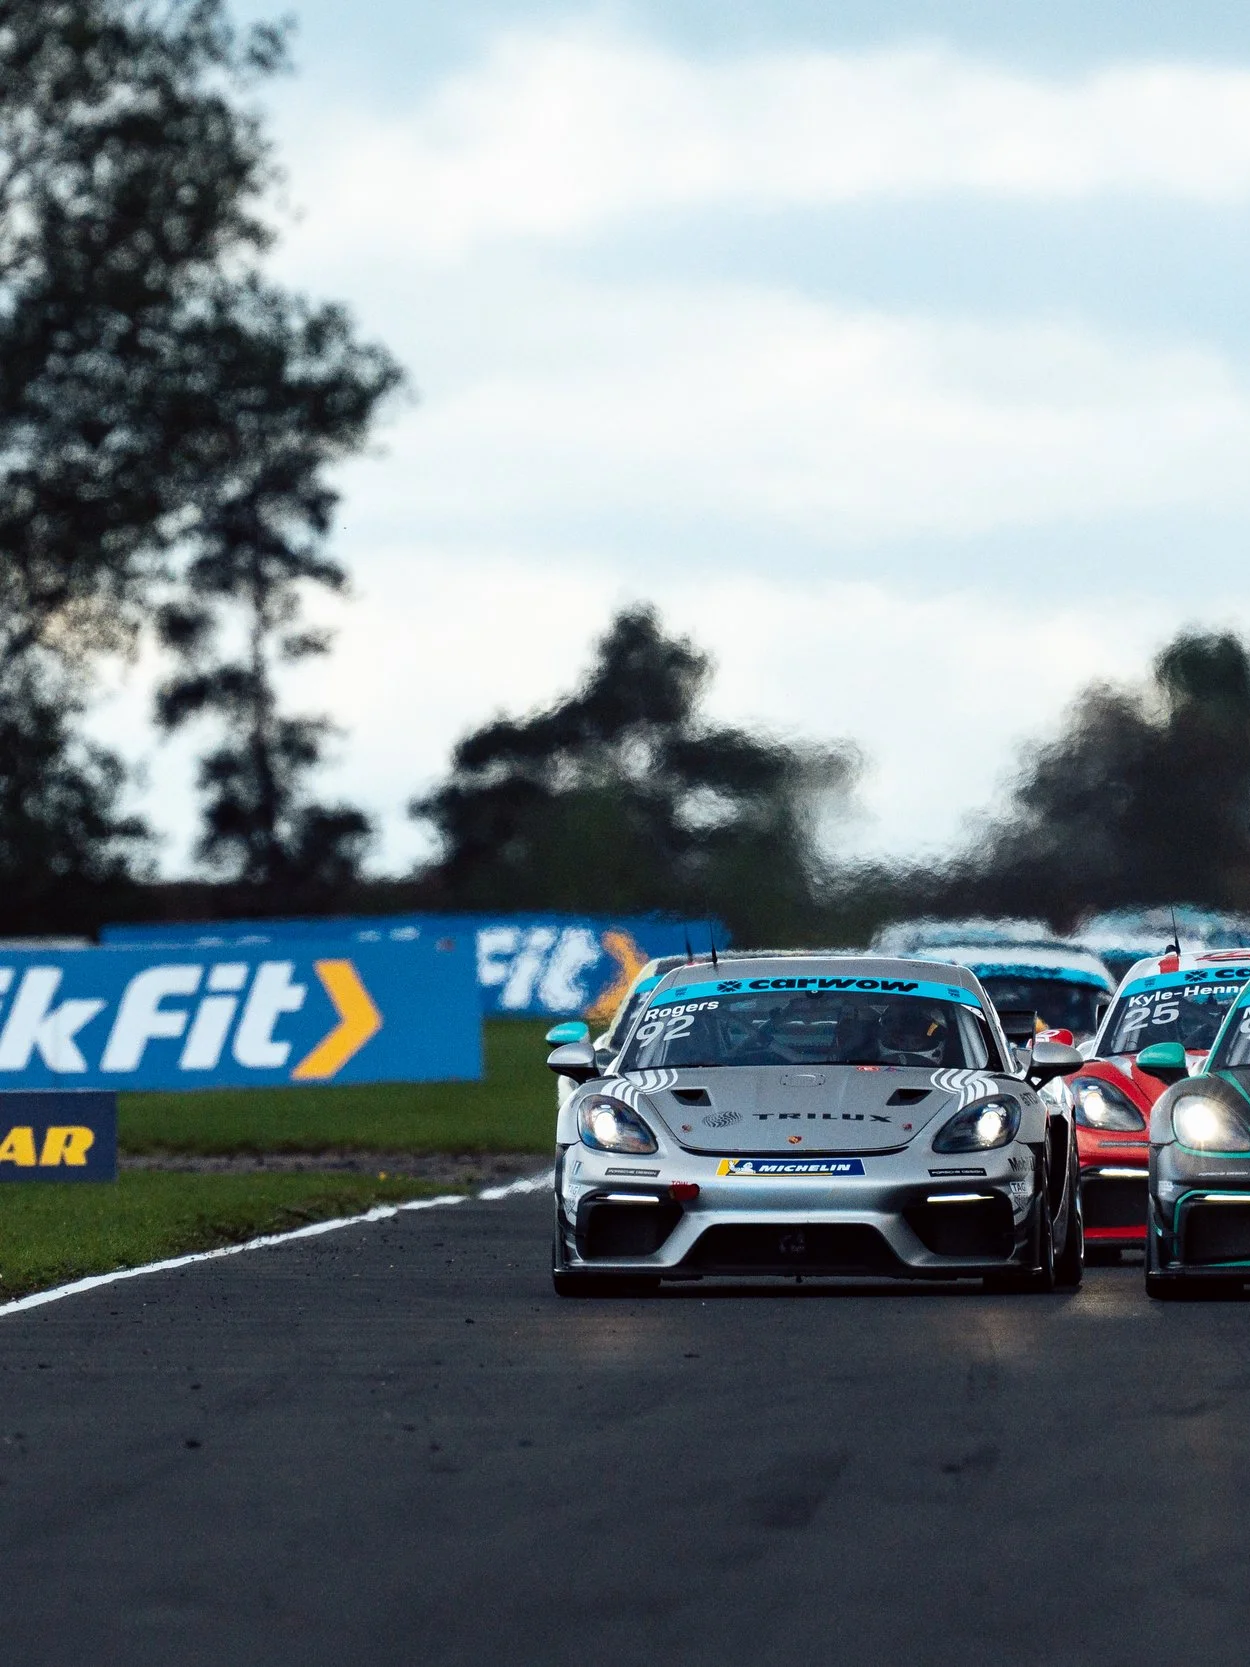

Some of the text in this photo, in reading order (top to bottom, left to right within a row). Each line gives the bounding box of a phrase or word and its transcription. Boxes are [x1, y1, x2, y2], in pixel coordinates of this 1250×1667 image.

[748, 977, 919, 992] carwow
[101, 961, 308, 1073] Fit
[644, 1001, 720, 1022] Rogers
[1123, 1001, 1180, 1033] 25
[636, 1014, 695, 1048] 92
[752, 1112, 893, 1123] TRILUX
[758, 1163, 851, 1172] MICHELIN
[1011, 1182, 1026, 1191] TAG
